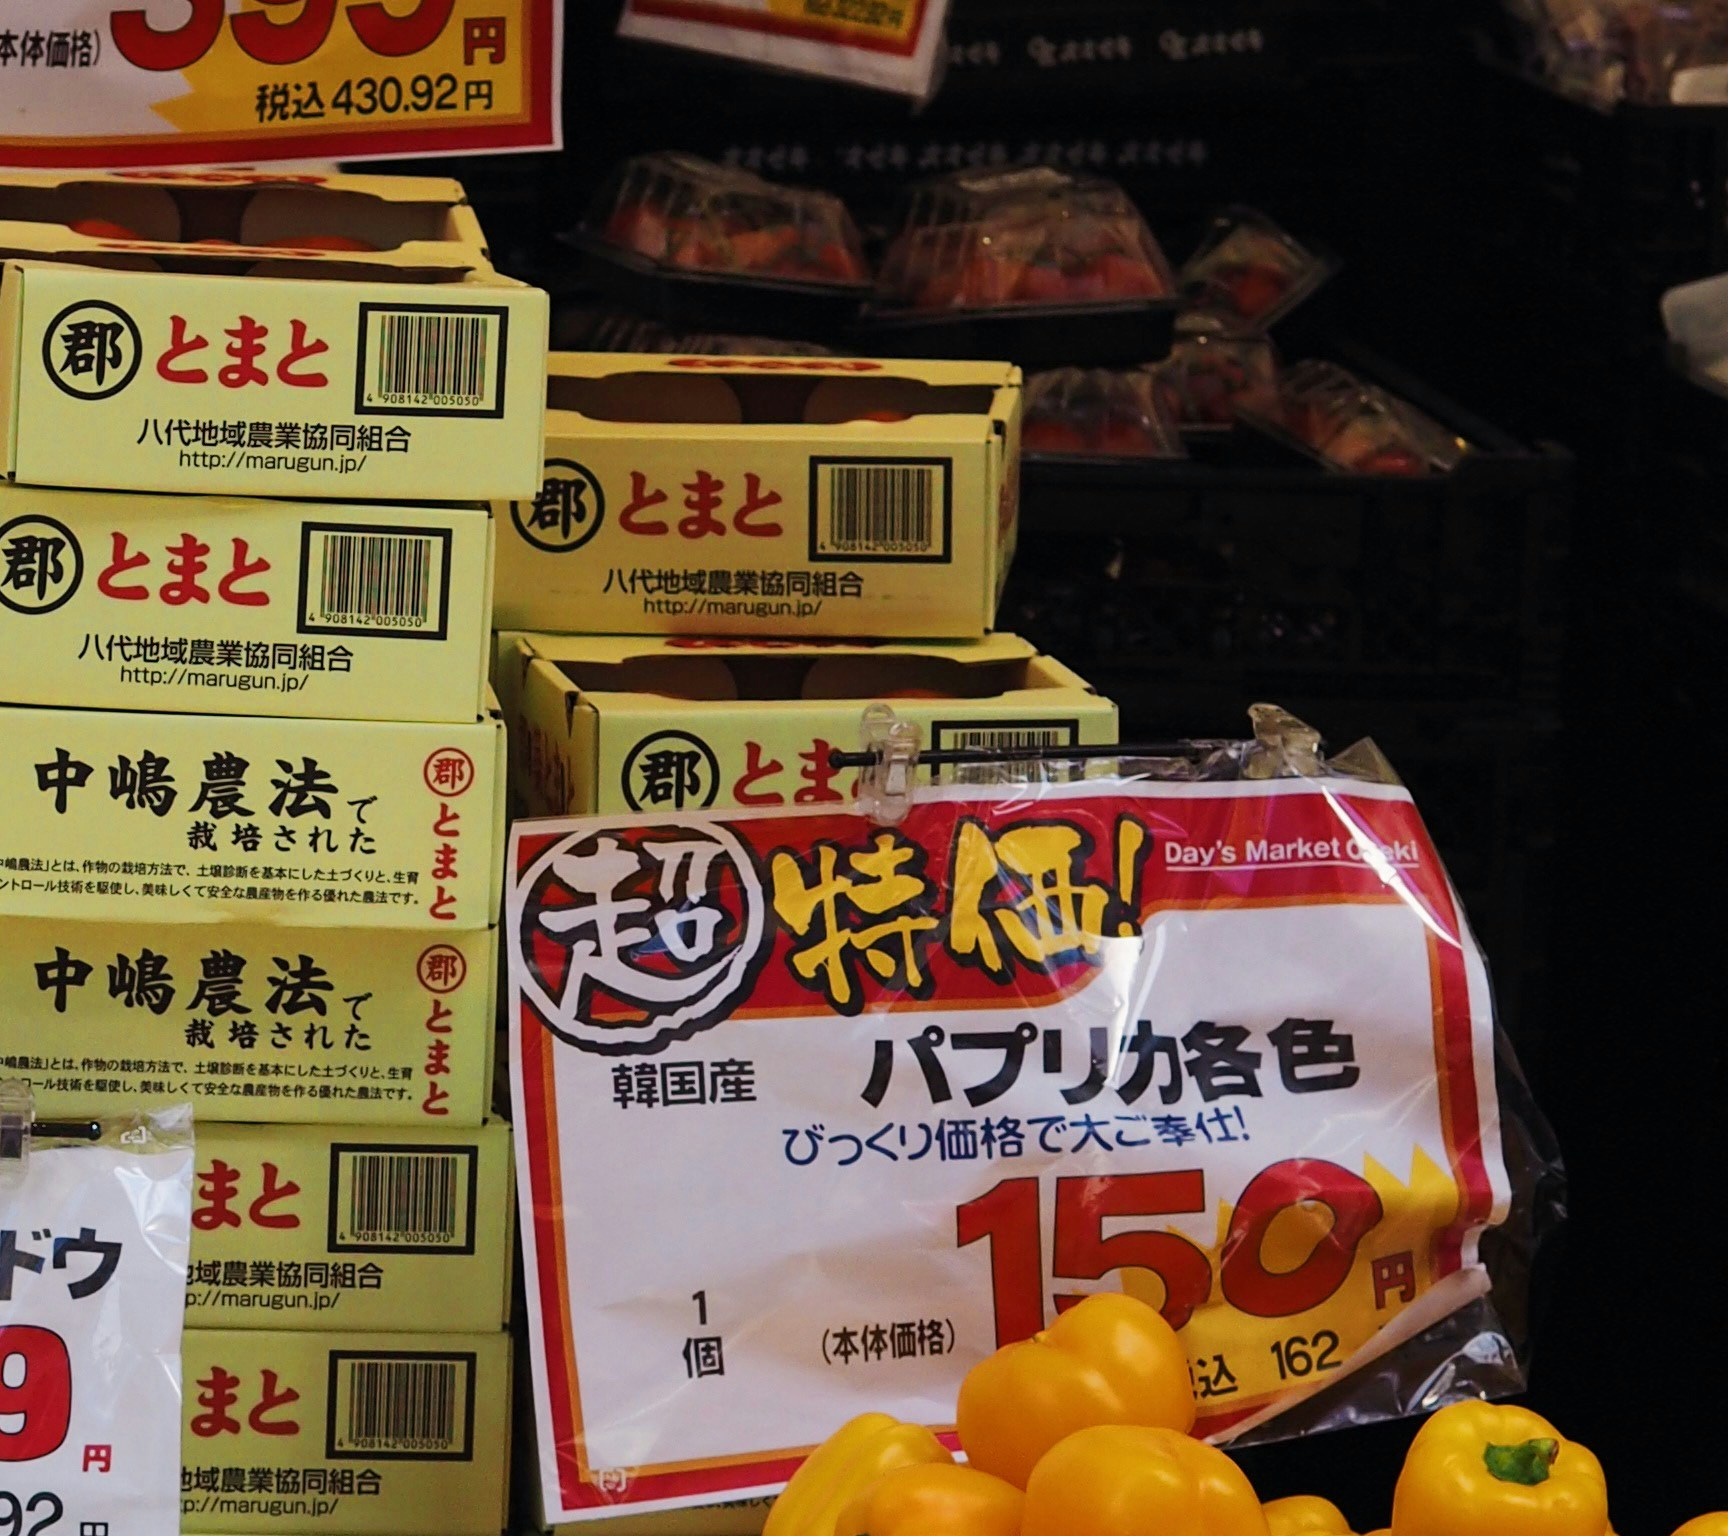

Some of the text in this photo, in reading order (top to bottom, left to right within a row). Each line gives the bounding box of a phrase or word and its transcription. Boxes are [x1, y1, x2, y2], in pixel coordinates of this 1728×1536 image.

[154, 313, 330, 389] とまと
[136, 417, 412, 454] 八代地域農業協同組合
[178, 449, 369, 474] http://marugun.jp/
[618, 469, 784, 540] とまと
[95, 530, 272, 608] とまと
[602, 567, 865, 599] 八代地域農業協同組合
[643, 597, 822, 619] http://marugun.jp/
[77, 632, 355, 674] 八代地域農業協同組合
[119, 666, 311, 693] http://marugun.jp/
[731, 738, 862, 807] とま
[186, 820, 379, 855] 栽培された
[428, 802, 461, 923] とまと
[538, 815, 1341, 1023] 超 特価! Day's Market
[183, 1018, 372, 1052] 栽培された
[421, 998, 453, 1117] とまと
[611, 1060, 758, 1110] 韓国産
[862, 1017, 1361, 1108] パプリカ各色
[782, 1106, 1251, 1167] びっくり価格で大ご奉仕!
[691, 1290, 709, 1326] 1
[682, 1335, 724, 1379] 個
[1272, 1330, 1342, 1382] 162
